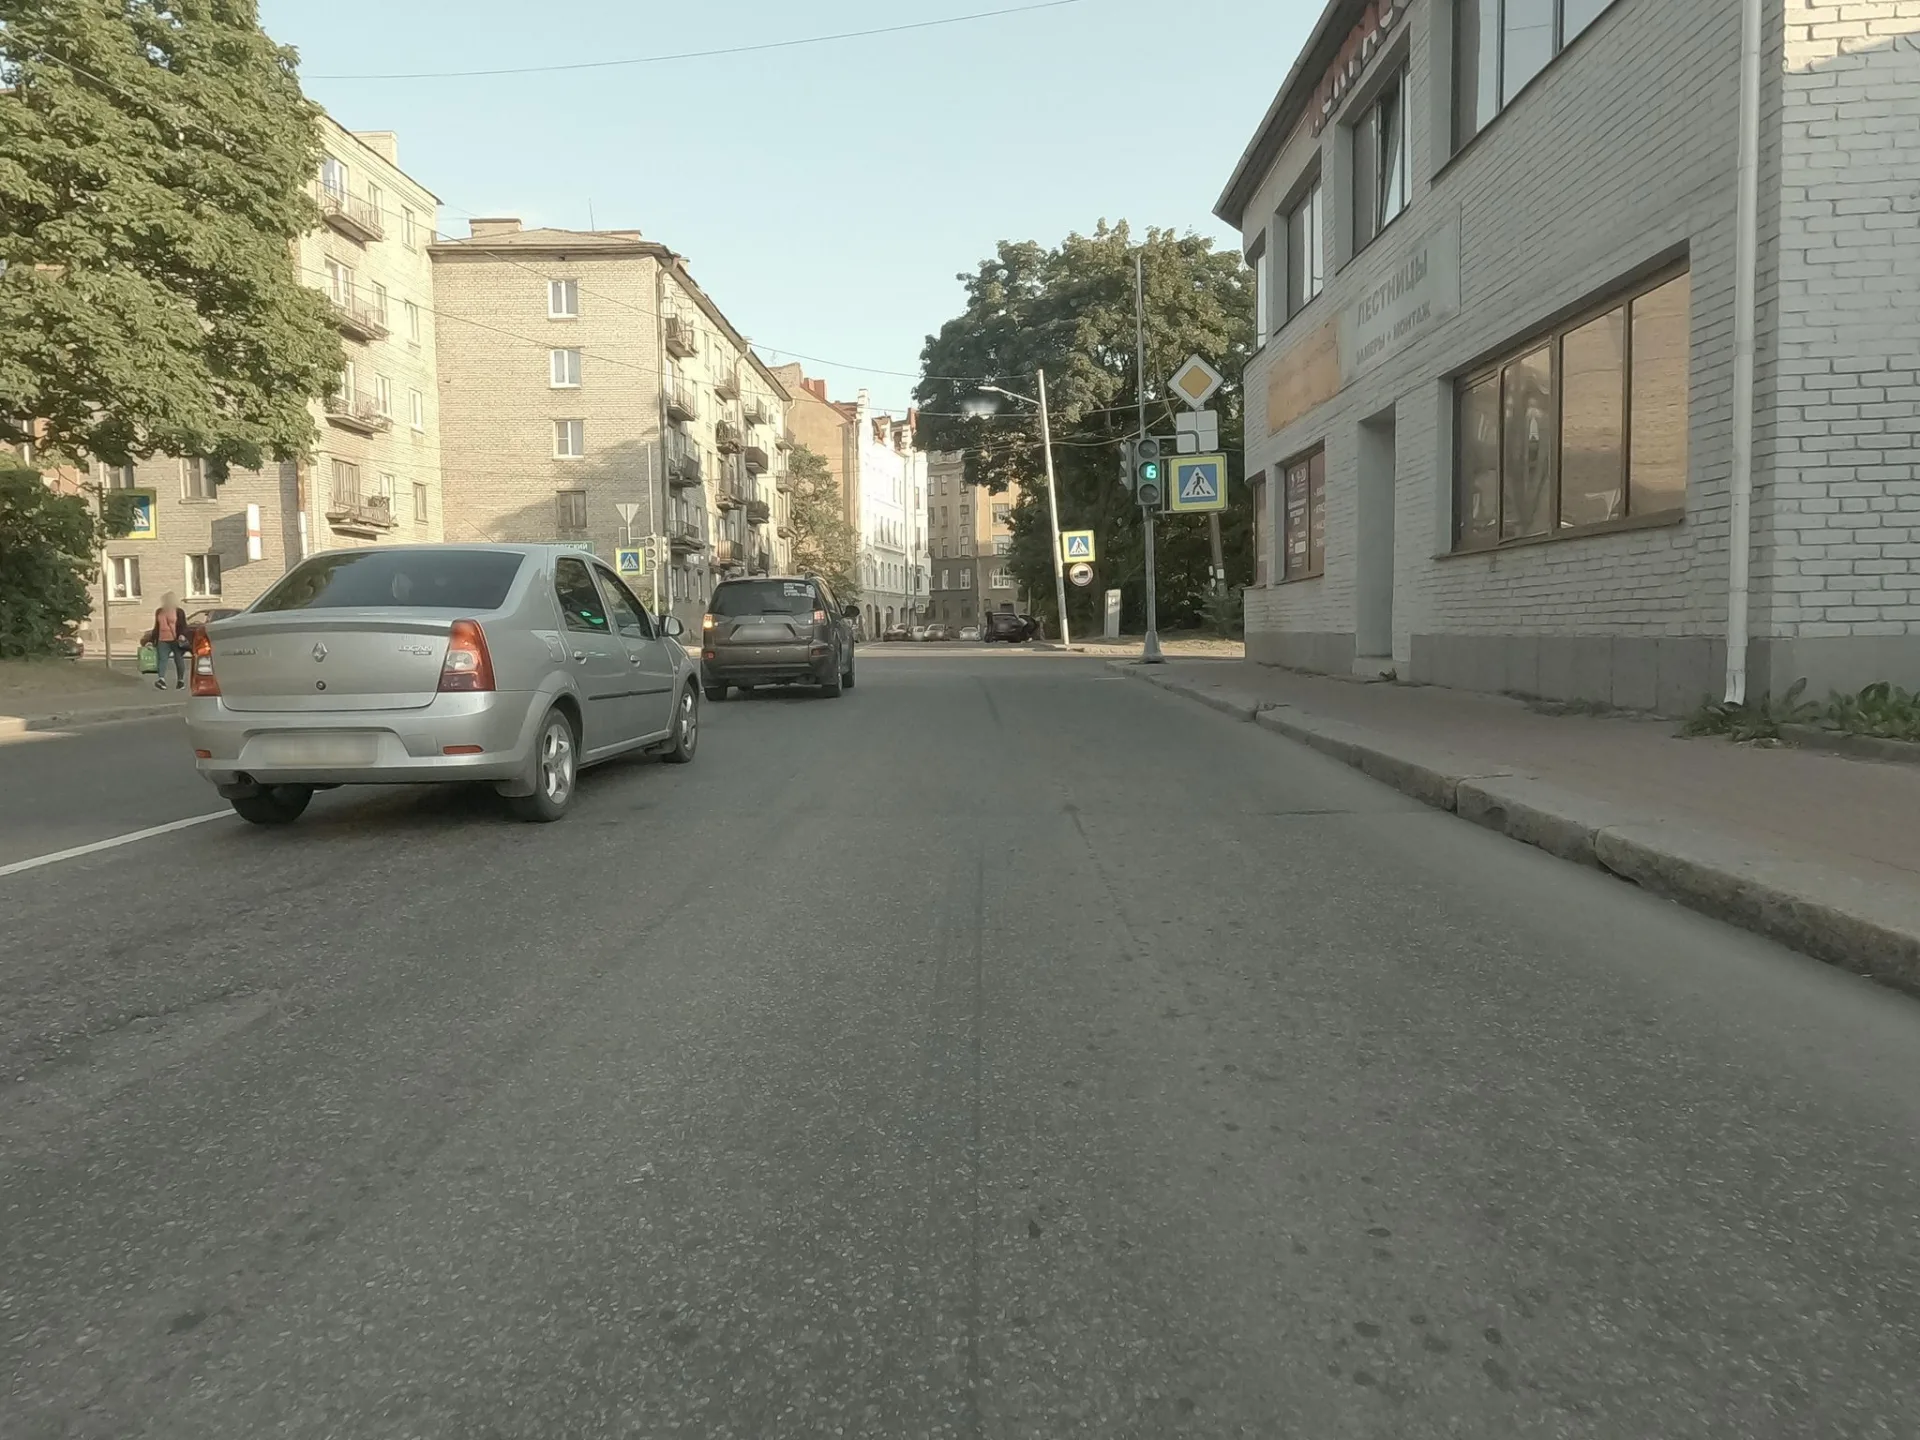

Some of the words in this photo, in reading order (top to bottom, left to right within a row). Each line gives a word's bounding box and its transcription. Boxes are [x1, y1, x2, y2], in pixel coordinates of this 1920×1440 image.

[1357, 249, 1428, 328] ЛЕСТНИЦЫ
[1393, 299, 1431, 341] МОНТАЖ
[1146, 465, 1157, 479] 6
[398, 644, 433, 652] LOGAN
